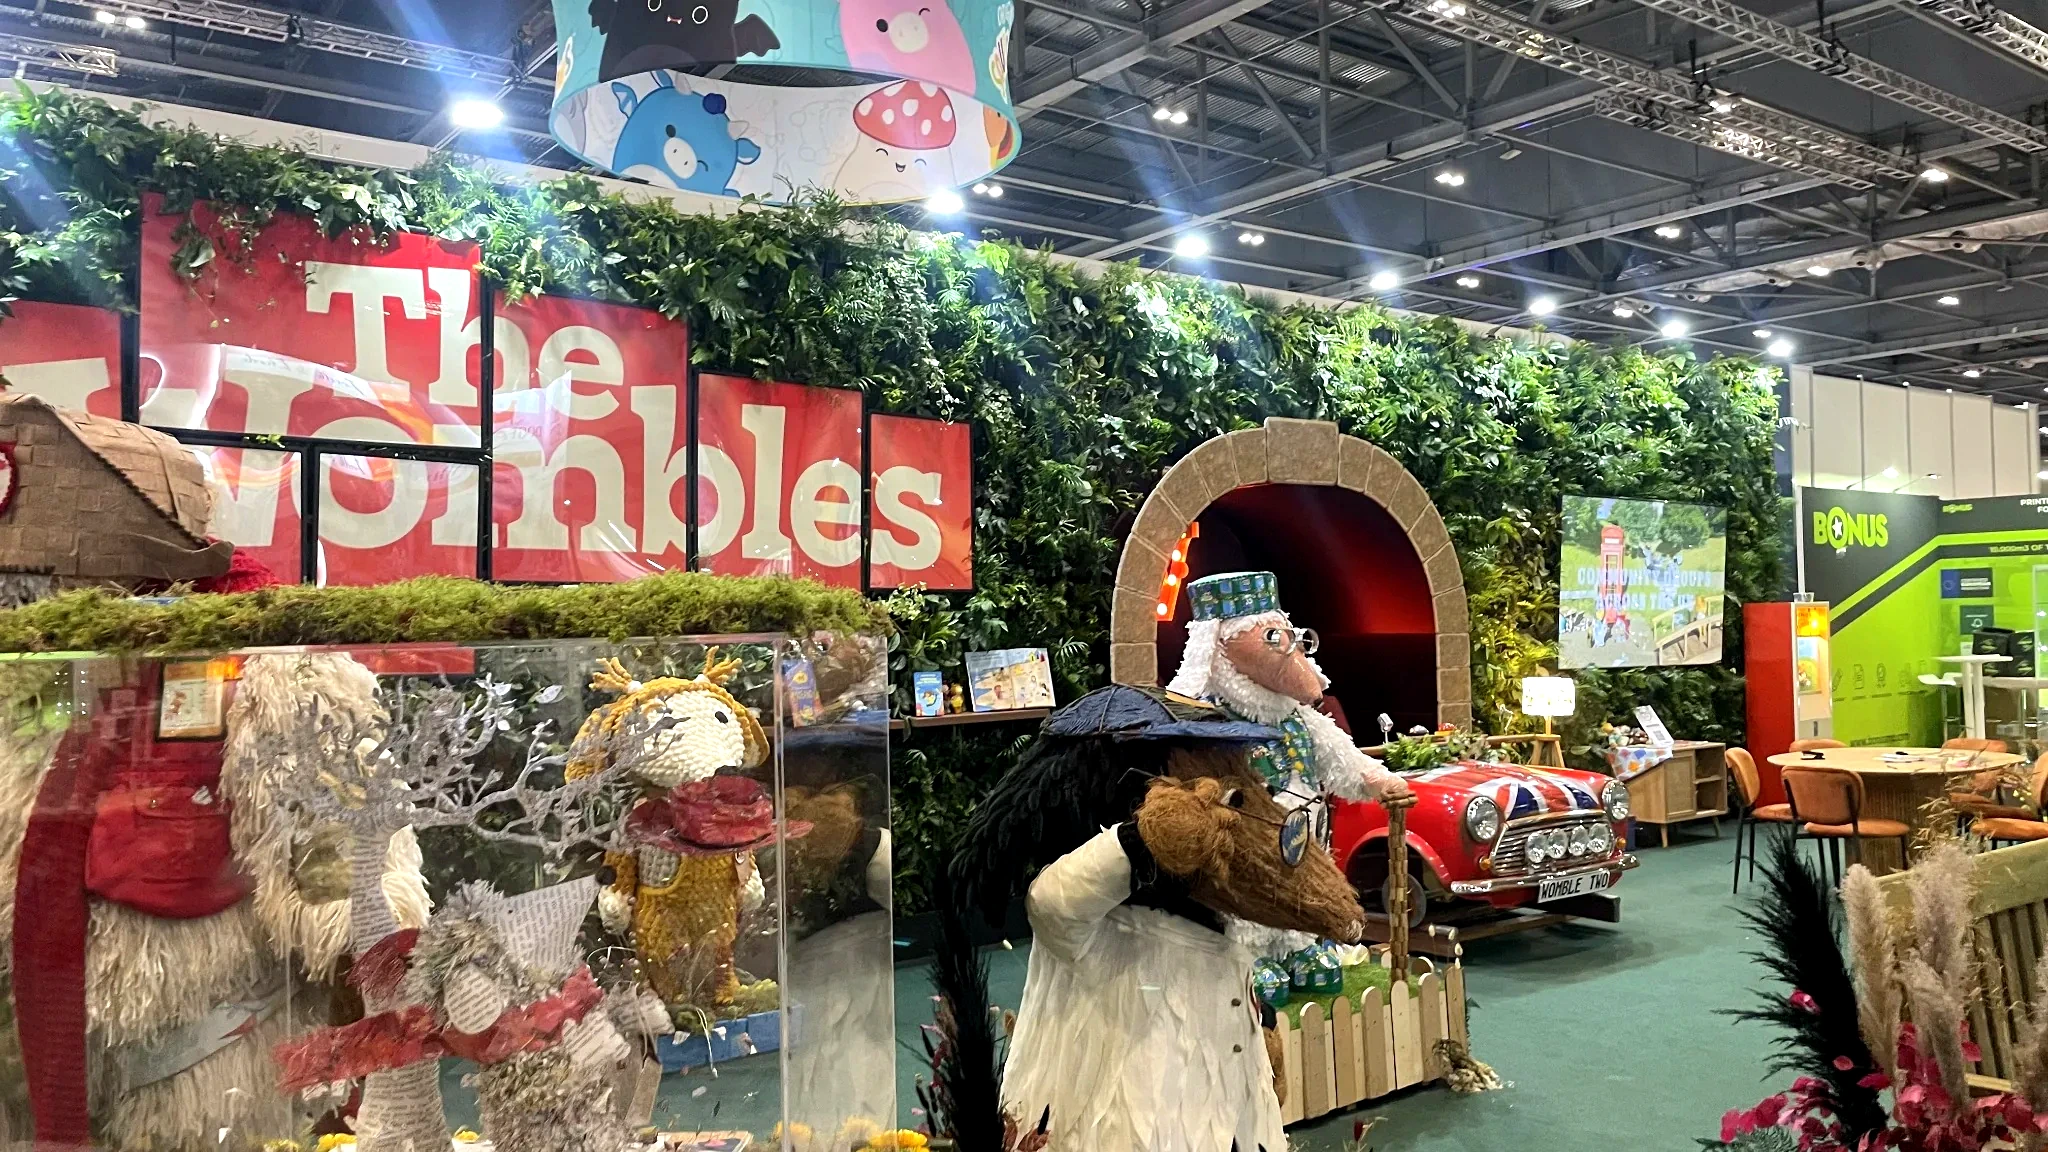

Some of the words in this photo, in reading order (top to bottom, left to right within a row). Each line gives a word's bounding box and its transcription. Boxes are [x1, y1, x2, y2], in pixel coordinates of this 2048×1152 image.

[304, 260, 624, 421] The
[1813, 506, 1889, 549] BONUS
[1541, 877, 1583, 899] WOMBLE
[1590, 872, 1609, 890] TWO
